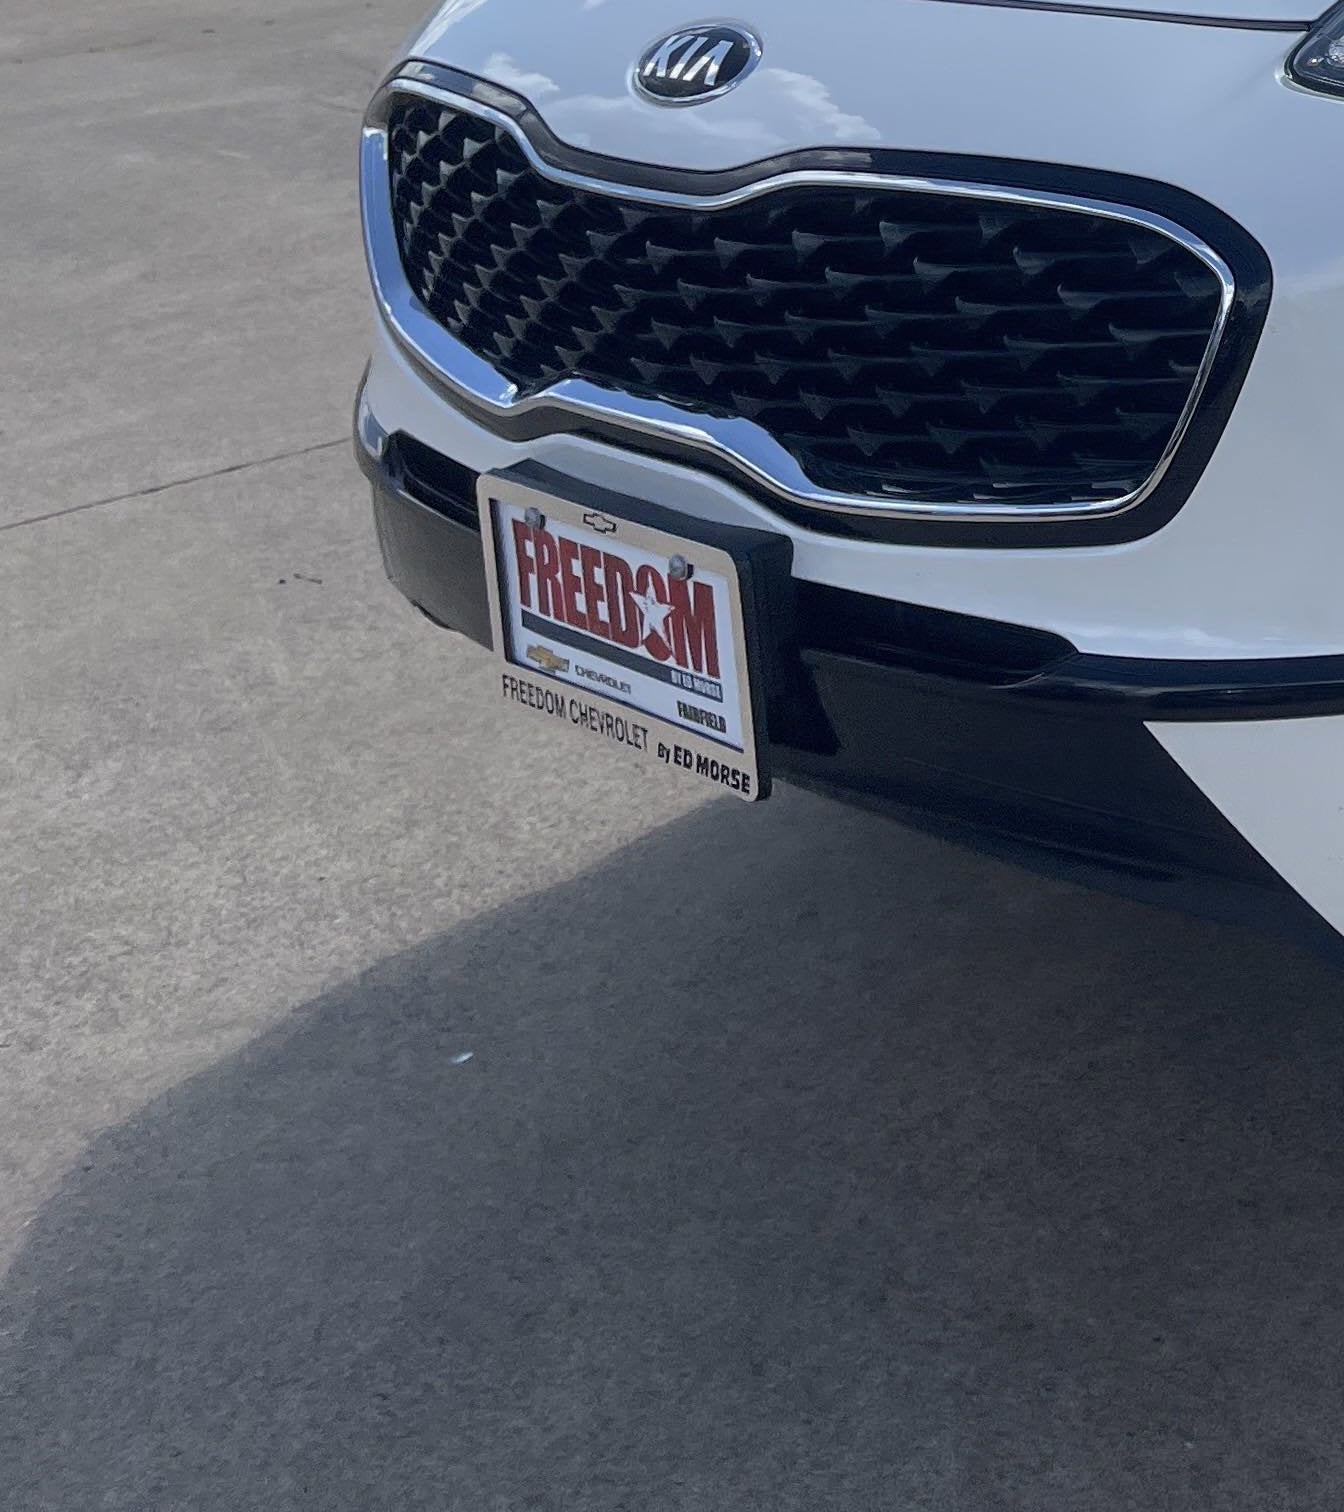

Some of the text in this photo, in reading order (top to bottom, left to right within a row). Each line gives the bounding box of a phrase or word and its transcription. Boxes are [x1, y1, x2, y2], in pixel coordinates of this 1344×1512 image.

[642, 34, 735, 87] KIA
[511, 517, 721, 680] FREEDOM
[574, 664, 632, 695] CHEVROLET
[502, 673, 567, 720] FREEDOM
[569, 698, 649, 752] CHEVROLET
[673, 744, 693, 770] ED
[696, 753, 751, 794] MORSE
